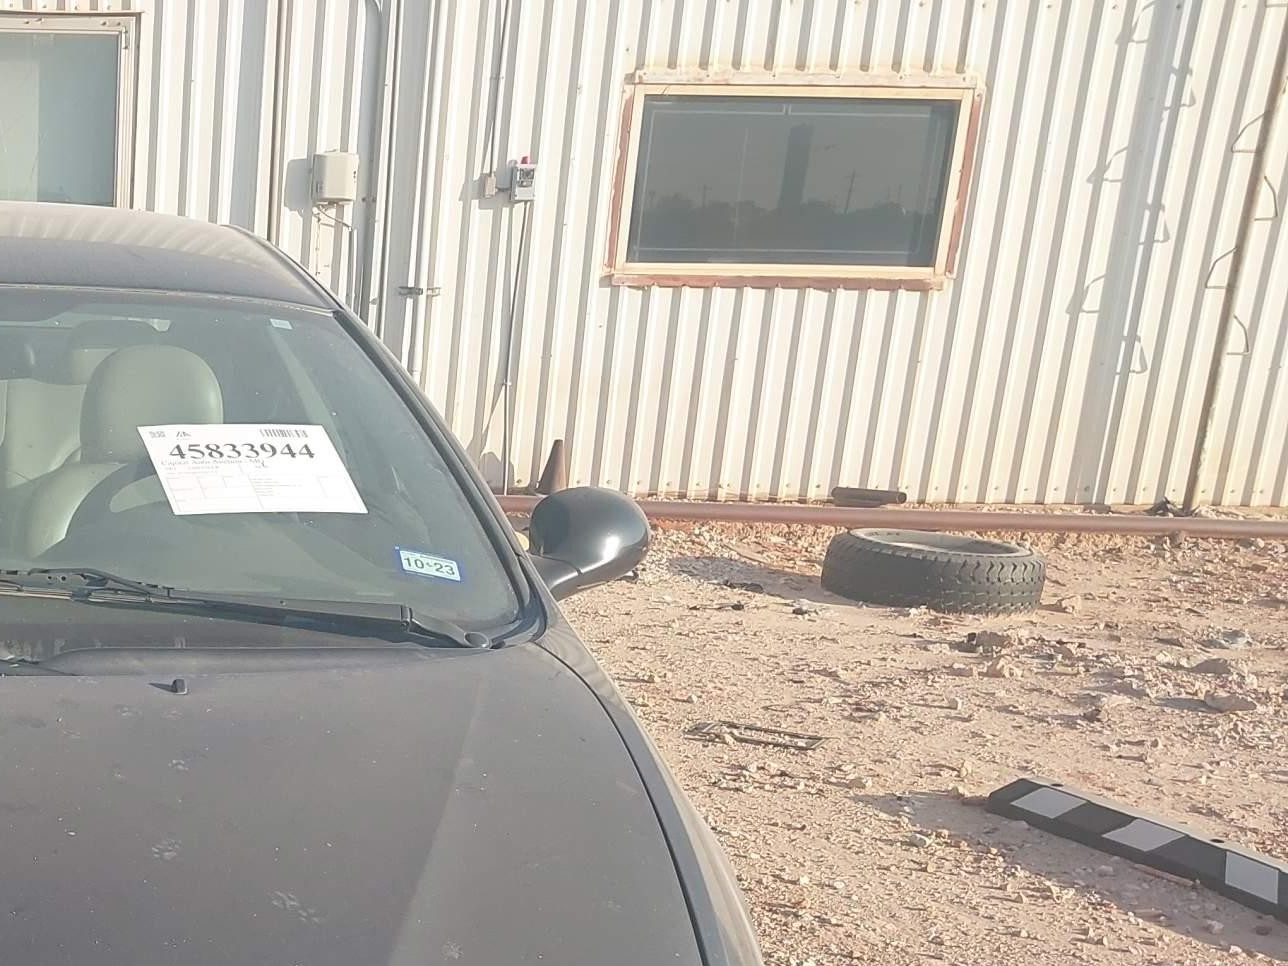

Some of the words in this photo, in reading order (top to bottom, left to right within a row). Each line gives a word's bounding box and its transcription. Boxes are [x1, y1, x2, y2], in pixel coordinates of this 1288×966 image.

[169, 443, 315, 459] 45833944
[404, 557, 424, 569] 10
[434, 562, 455, 576] 23
